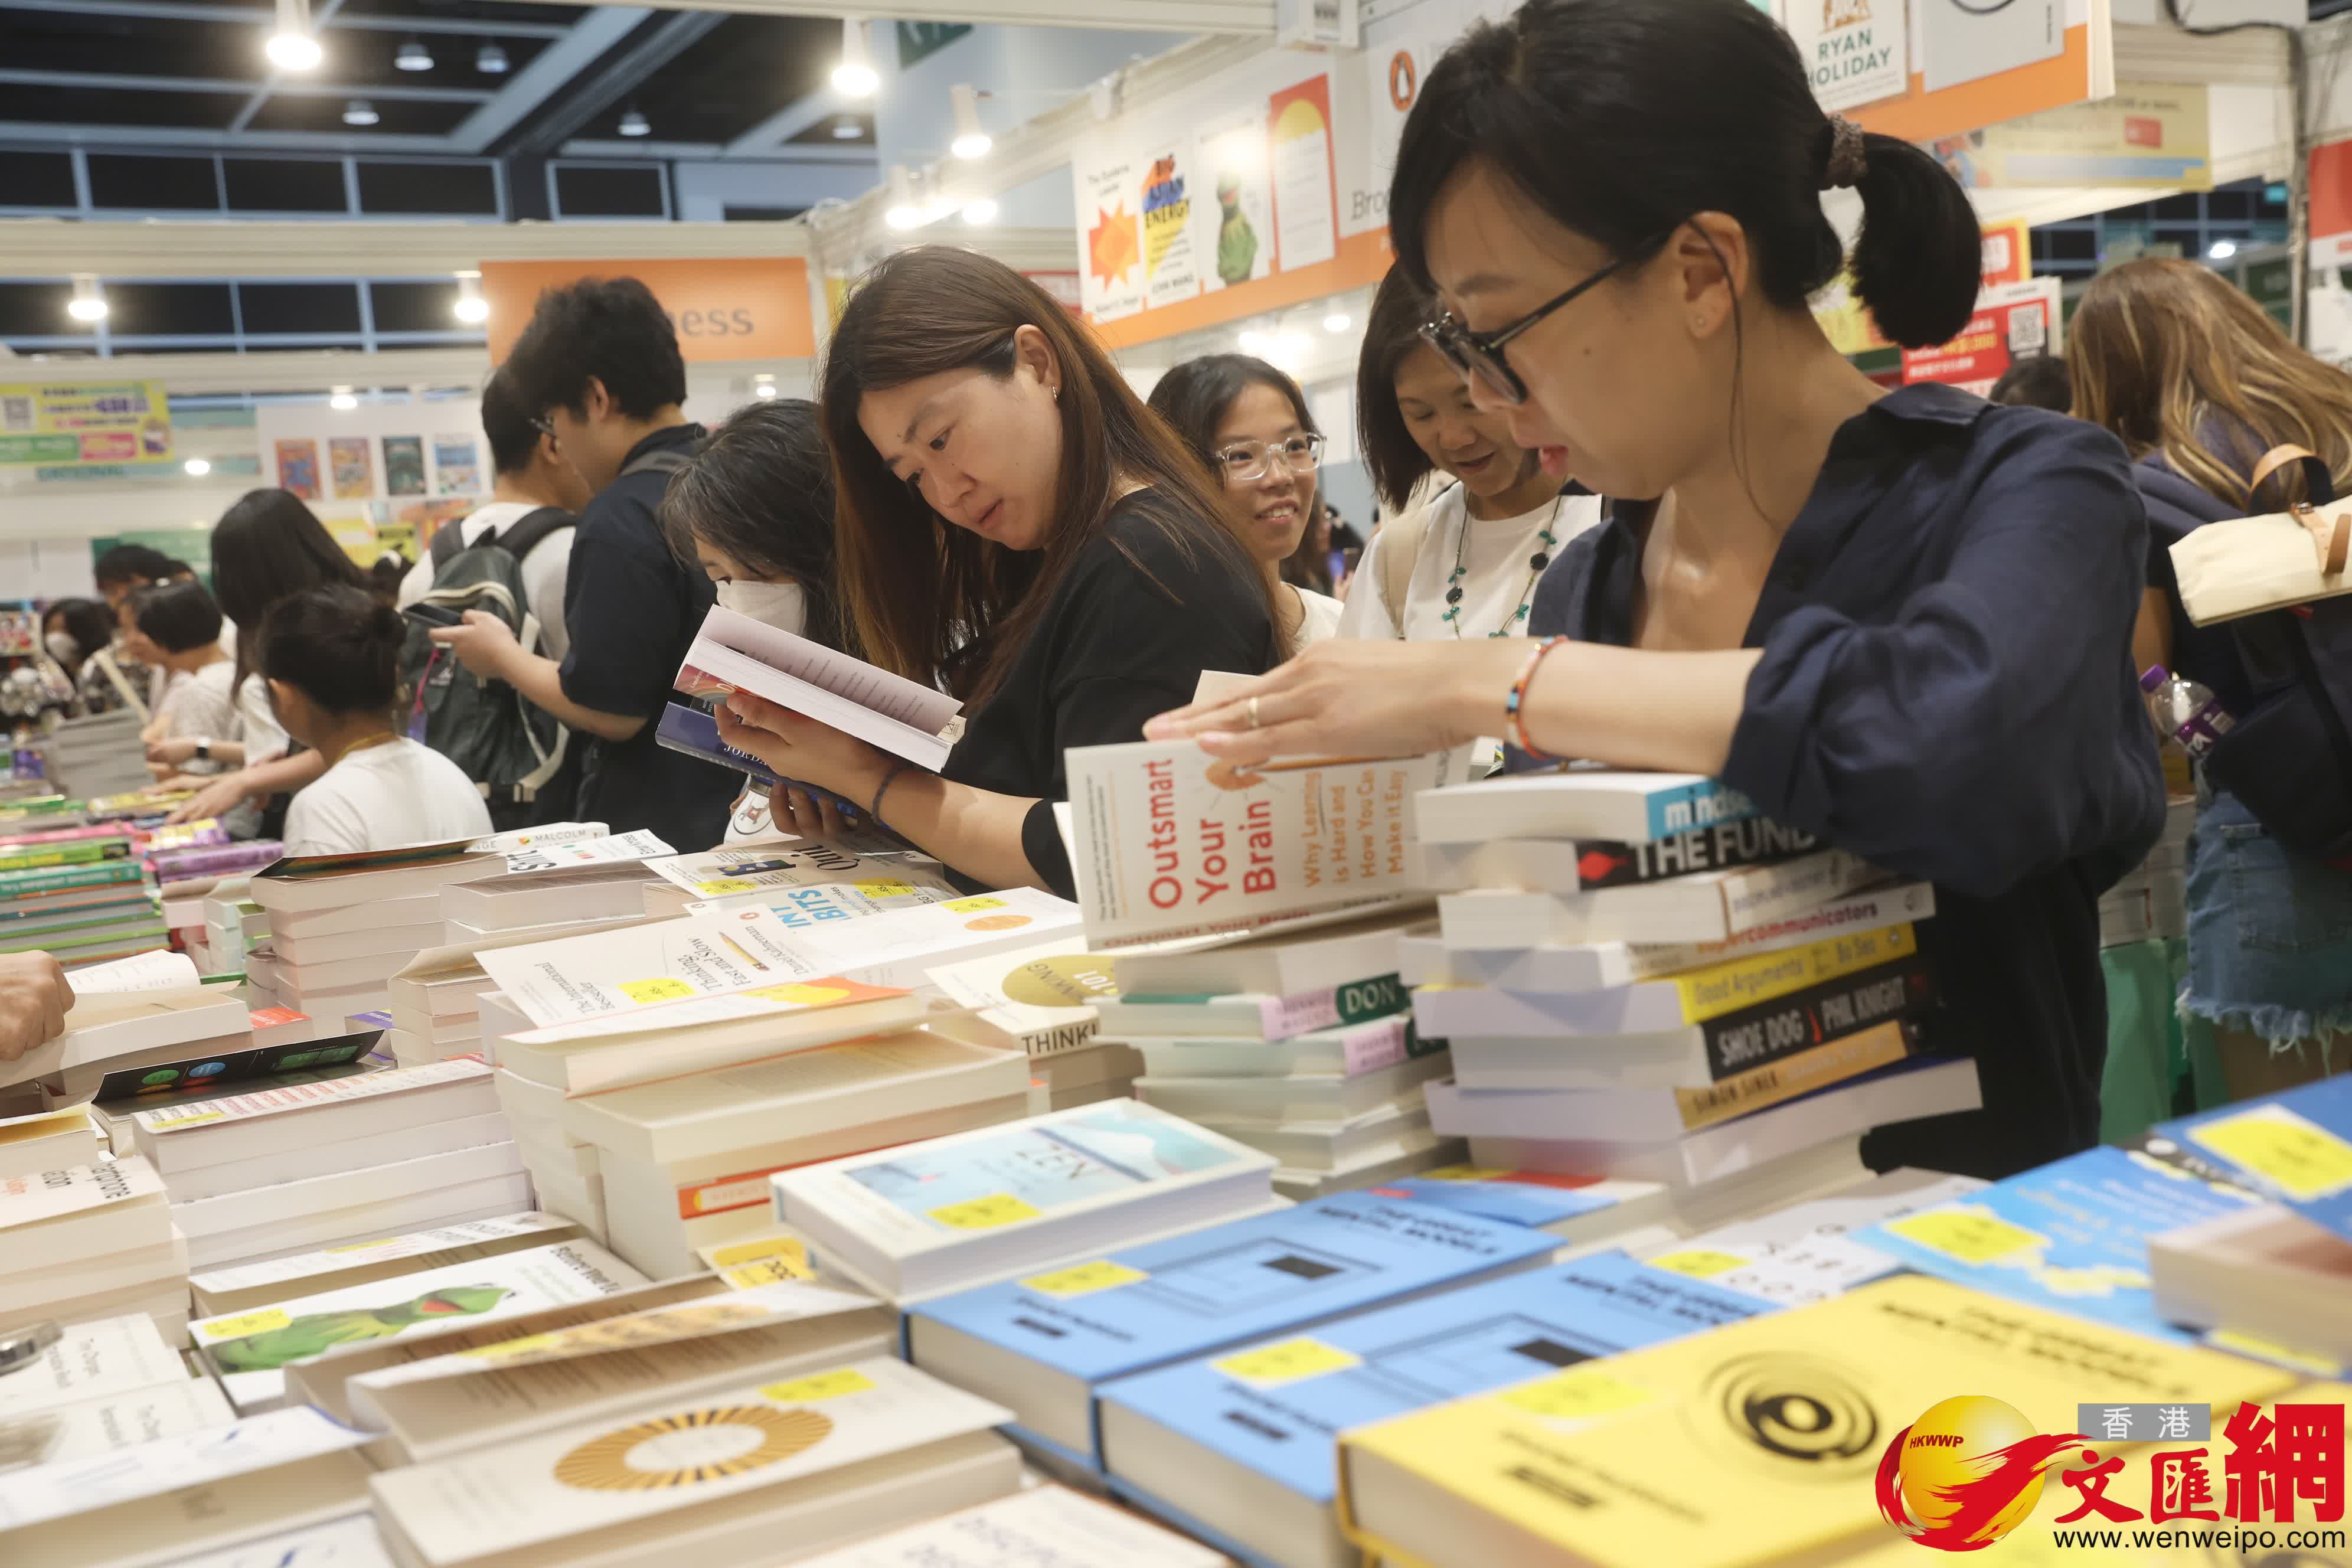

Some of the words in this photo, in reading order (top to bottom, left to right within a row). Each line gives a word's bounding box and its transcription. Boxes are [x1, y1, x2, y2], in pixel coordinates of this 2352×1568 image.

[1818, 28, 1872, 63] RYAN
[667, 306, 754, 337] ess
[1331, 785, 1346, 814] and
[1356, 798, 1374, 831] You
[535, 829, 586, 841] MALCOLM
[1141, 759, 1182, 910] Outsmart
[1237, 801, 1277, 894] Brain
[1331, 816, 1347, 863] Hard
[1360, 834, 1377, 878] How
[1386, 821, 1404, 874] Make
[1627, 828, 1709, 879] THE
[1194, 818, 1230, 905] Your
[1302, 841, 1322, 888] Why
[830, 886, 848, 901] makes
[687, 936, 717, 962] Slow
[1837, 939, 1854, 964] Bo
[1855, 936, 1876, 958] Seo
[1696, 975, 1729, 1006] Good
[1733, 955, 1803, 996] Arguments
[1717, 1022, 1765, 1067] SHOE
[1766, 1008, 1804, 1050] DOG
[1820, 993, 1856, 1031] PHIL
[1855, 976, 1906, 1020] KNIGHT
